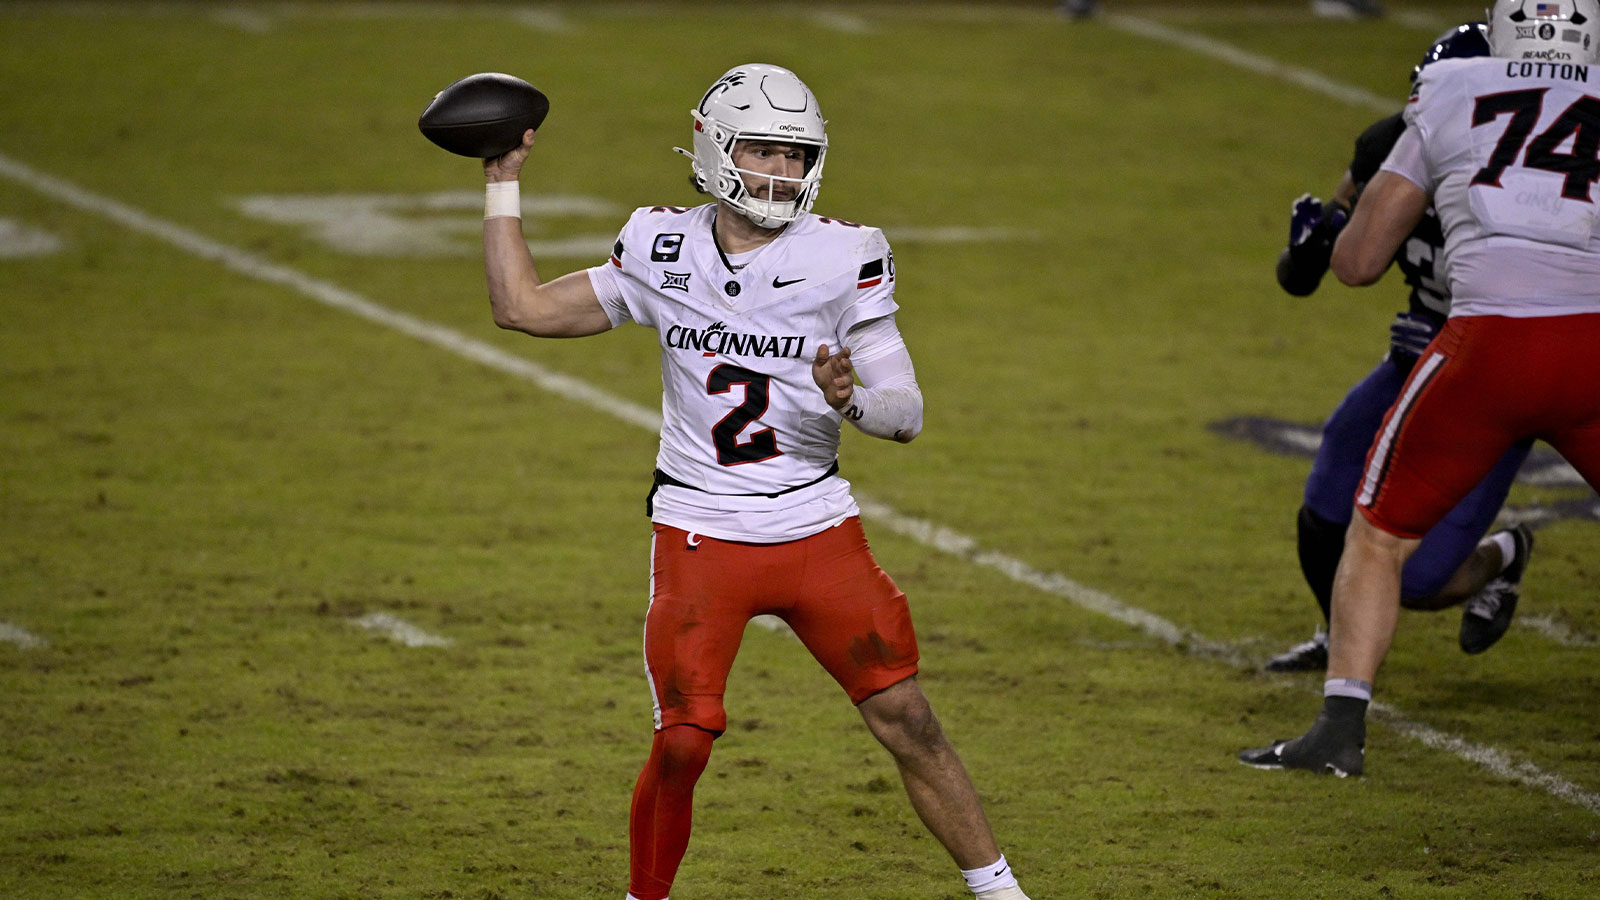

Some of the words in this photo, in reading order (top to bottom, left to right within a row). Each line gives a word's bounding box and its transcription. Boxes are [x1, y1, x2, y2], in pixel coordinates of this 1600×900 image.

[1522, 49, 1571, 60] BEARCATS
[1506, 61, 1588, 83] COTTON
[1469, 87, 1600, 204] 74
[655, 235, 681, 254] C
[666, 321, 806, 358] CINCINNATI
[707, 363, 784, 466] 2
